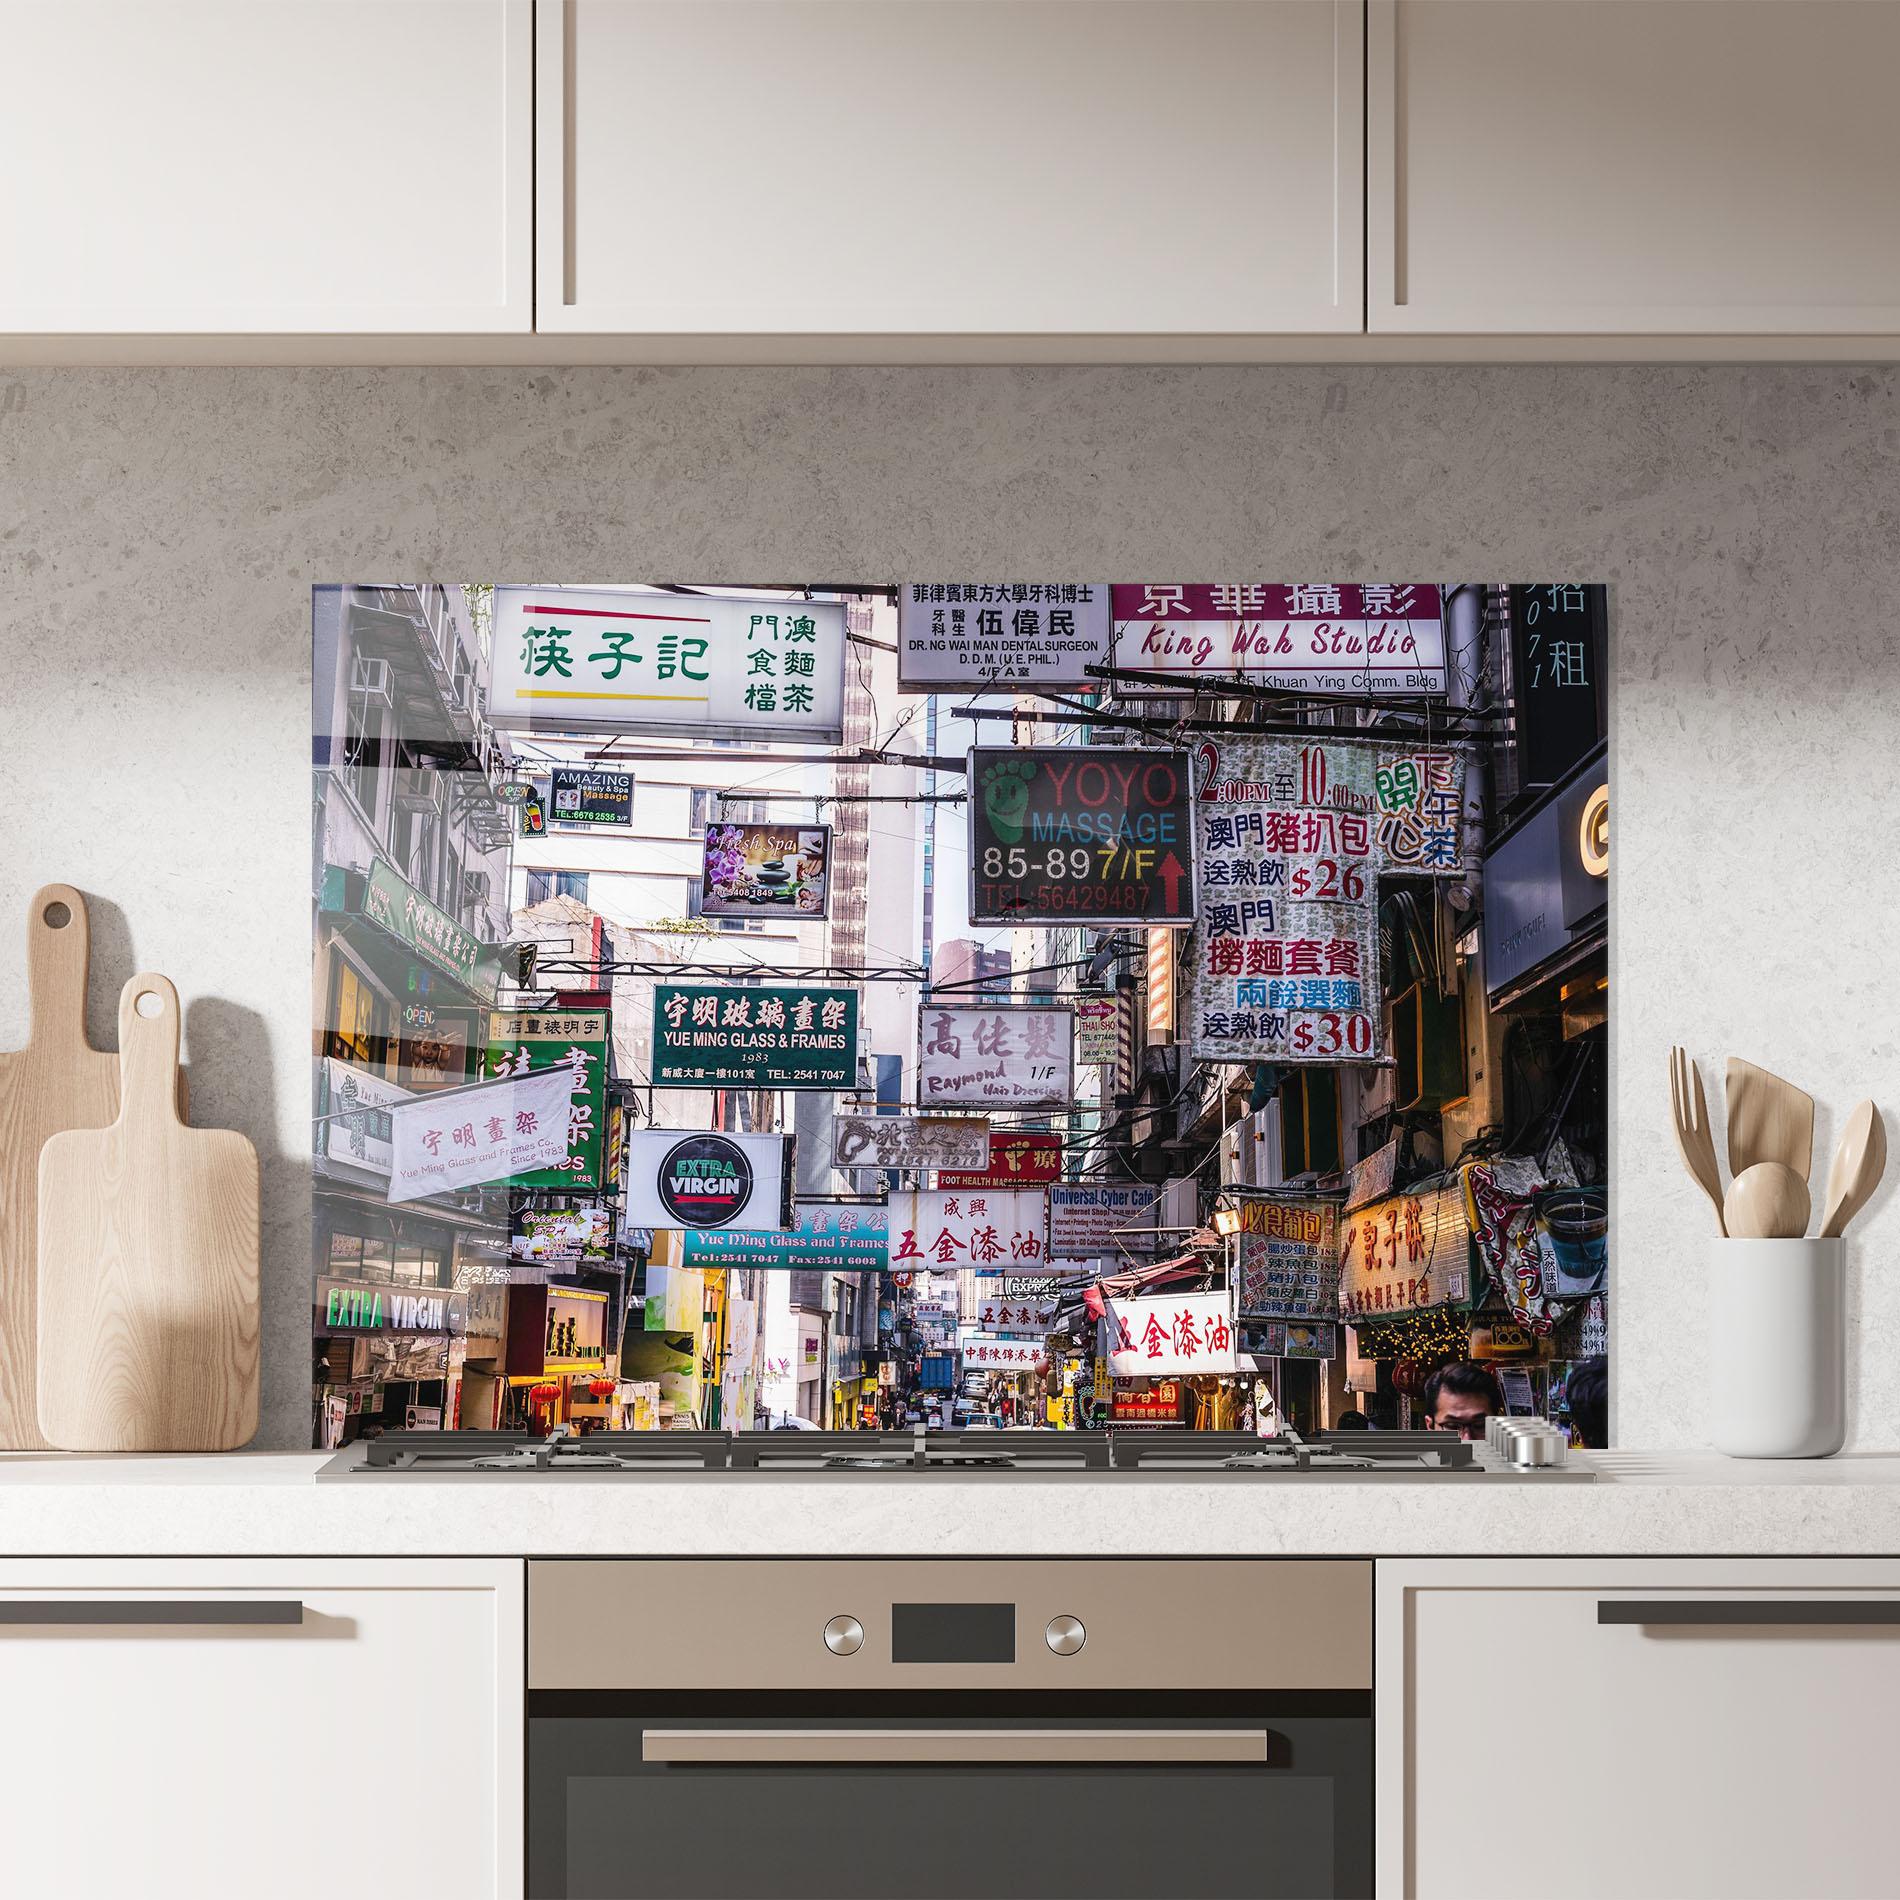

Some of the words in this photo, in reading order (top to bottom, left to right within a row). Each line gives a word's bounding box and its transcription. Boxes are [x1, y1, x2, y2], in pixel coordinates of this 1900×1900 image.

[909, 640, 928, 650] DR.
[929, 640, 946, 650] NG
[949, 640, 970, 650] WAI
[973, 640, 998, 650] MAN
[1141, 623, 1215, 666] King
[1232, 623, 1293, 654] Wah
[1311, 622, 1415, 655] Studio
[519, 626, 710, 681] 筷子記
[1263, 676, 1308, 688] Khuan
[1314, 676, 1345, 691] Ying
[1351, 675, 1400, 688] Comm.
[1406, 675, 1437, 691] Bldg
[557, 772, 629, 787] AMAZING
[1044, 762, 1177, 807] YOYO
[1274, 773, 1296, 801] 至
[498, 786, 530, 797] OPEN
[577, 784, 605, 793] Beauty
[613, 785, 629, 794] Spa
[583, 790, 628, 802] Massage
[595, 811, 615, 821] 2535
[1032, 812, 1176, 843] MASSAGE
[716, 834, 760, 851] Fresh
[763, 836, 795, 857] Spa
[983, 847, 1090, 880] 85-89
[1097, 850, 1155, 880] 7/F
[1203, 859, 1284, 886] 送熱飲
[1292, 859, 1364, 901] $26
[752, 889, 773, 897] 1849
[1205, 900, 1275, 938] 澳門
[1207, 938, 1361, 978] 撈麵套餐
[406, 1007, 432, 1024] OPEN
[664, 992, 847, 1031] 宇明玻璃畫架
[1082, 1022, 1098, 1030] THAI
[1202, 1012, 1285, 1040] 送熱飲
[1294, 1014, 1371, 1054] $30
[664, 1031, 690, 1046] YUE
[694, 1032, 727, 1047] MING
[731, 1033, 775, 1047] GLASS
[778, 1035, 788, 1048] &
[791, 1034, 846, 1049] FRAMES
[742, 1053, 769, 1064] 1983
[767, 1070, 791, 1079] TEL:
[794, 1070, 818, 1080] 2541
[821, 1071, 846, 1080] 7047
[927, 1060, 1007, 1093] Raymond
[1031, 1066, 1056, 1080] 1/F
[983, 1083, 1009, 1096] Hair
[422, 1110, 539, 1156] 宇明畫架
[400, 1168, 419, 1180] Yue
[421, 1162, 446, 1176] Ming
[448, 1155, 476, 1169] Glass
[479, 1149, 497, 1162] and
[499, 1141, 536, 1157] Frames
[537, 1137, 554, 1148] Co.
[510, 1152, 536, 1165] Since
[540, 1145, 564, 1159] 1983
[677, 1160, 737, 1177] EXTRA
[572, 1174, 592, 1183] 1983
[669, 1177, 740, 1194] VIRGIN
[941, 1176, 960, 1184] FOOT
[962, 1177, 990, 1186] HEALTH
[1053, 1189, 1098, 1205] Universal
[1101, 1190, 1128, 1206] Cyber
[1132, 1189, 1153, 1205] Café
[522, 1211, 581, 1224] Oriental
[533, 1225, 567, 1236] SPA
[698, 1232, 723, 1245] Yue
[729, 1233, 766, 1248] Ming
[770, 1234, 806, 1247] Glass
[811, 1236, 835, 1248] and
[892, 1226, 1041, 1264] 五金漆油
[752, 1253, 779, 1262] 7047
[848, 1257, 877, 1265] 6008
[896, 1272, 908, 1285] 押
[1544, 1250, 1557, 1293] 天然味道
[327, 1287, 383, 1329] EXTRA
[391, 1294, 443, 1330] VIRGIN
